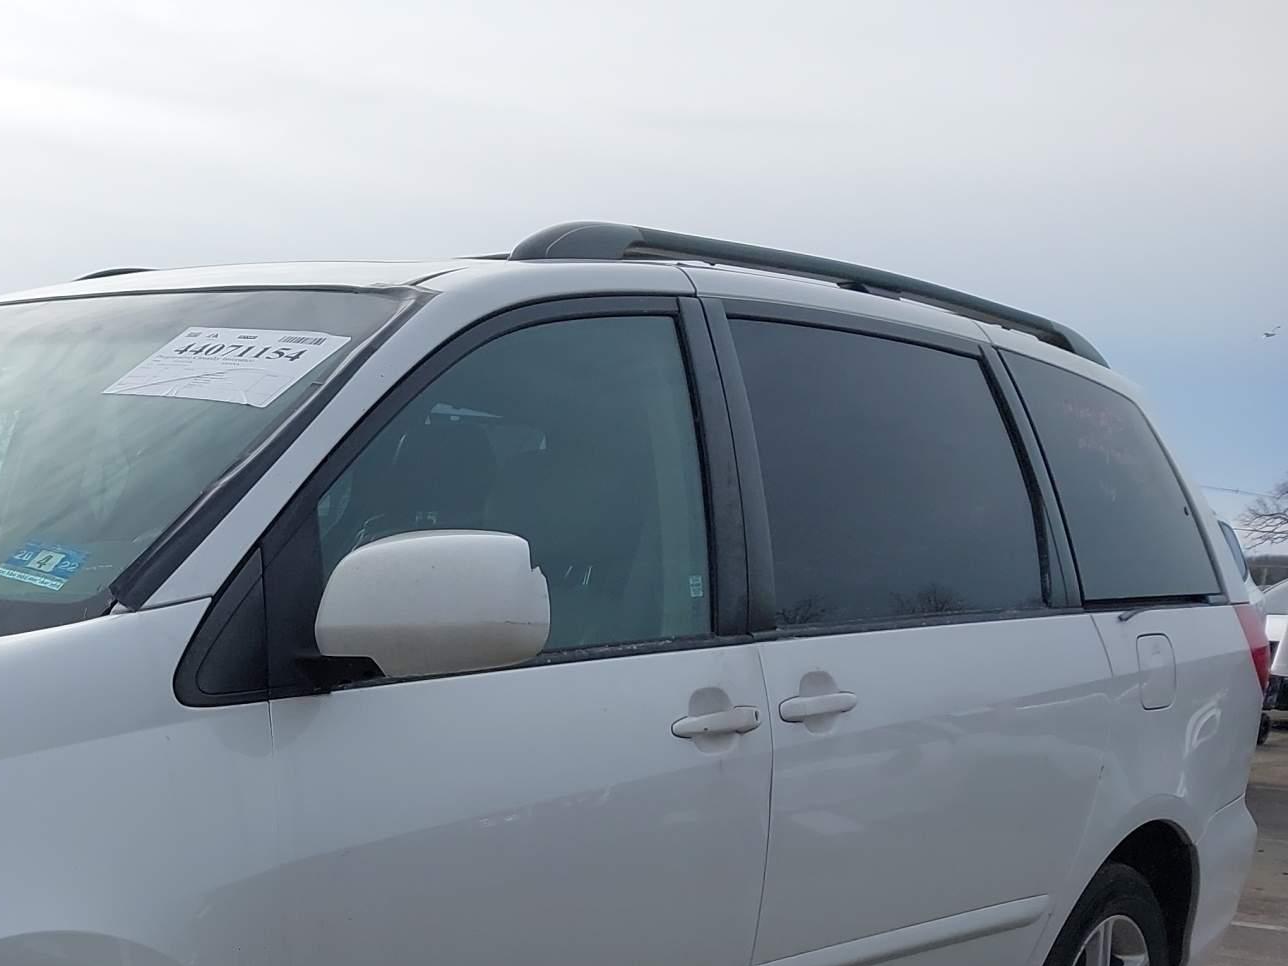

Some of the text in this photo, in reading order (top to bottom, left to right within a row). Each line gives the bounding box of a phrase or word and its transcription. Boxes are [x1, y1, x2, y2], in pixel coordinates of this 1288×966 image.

[174, 343, 308, 362] 44071154
[13, 550, 79, 572] 20 4 22
